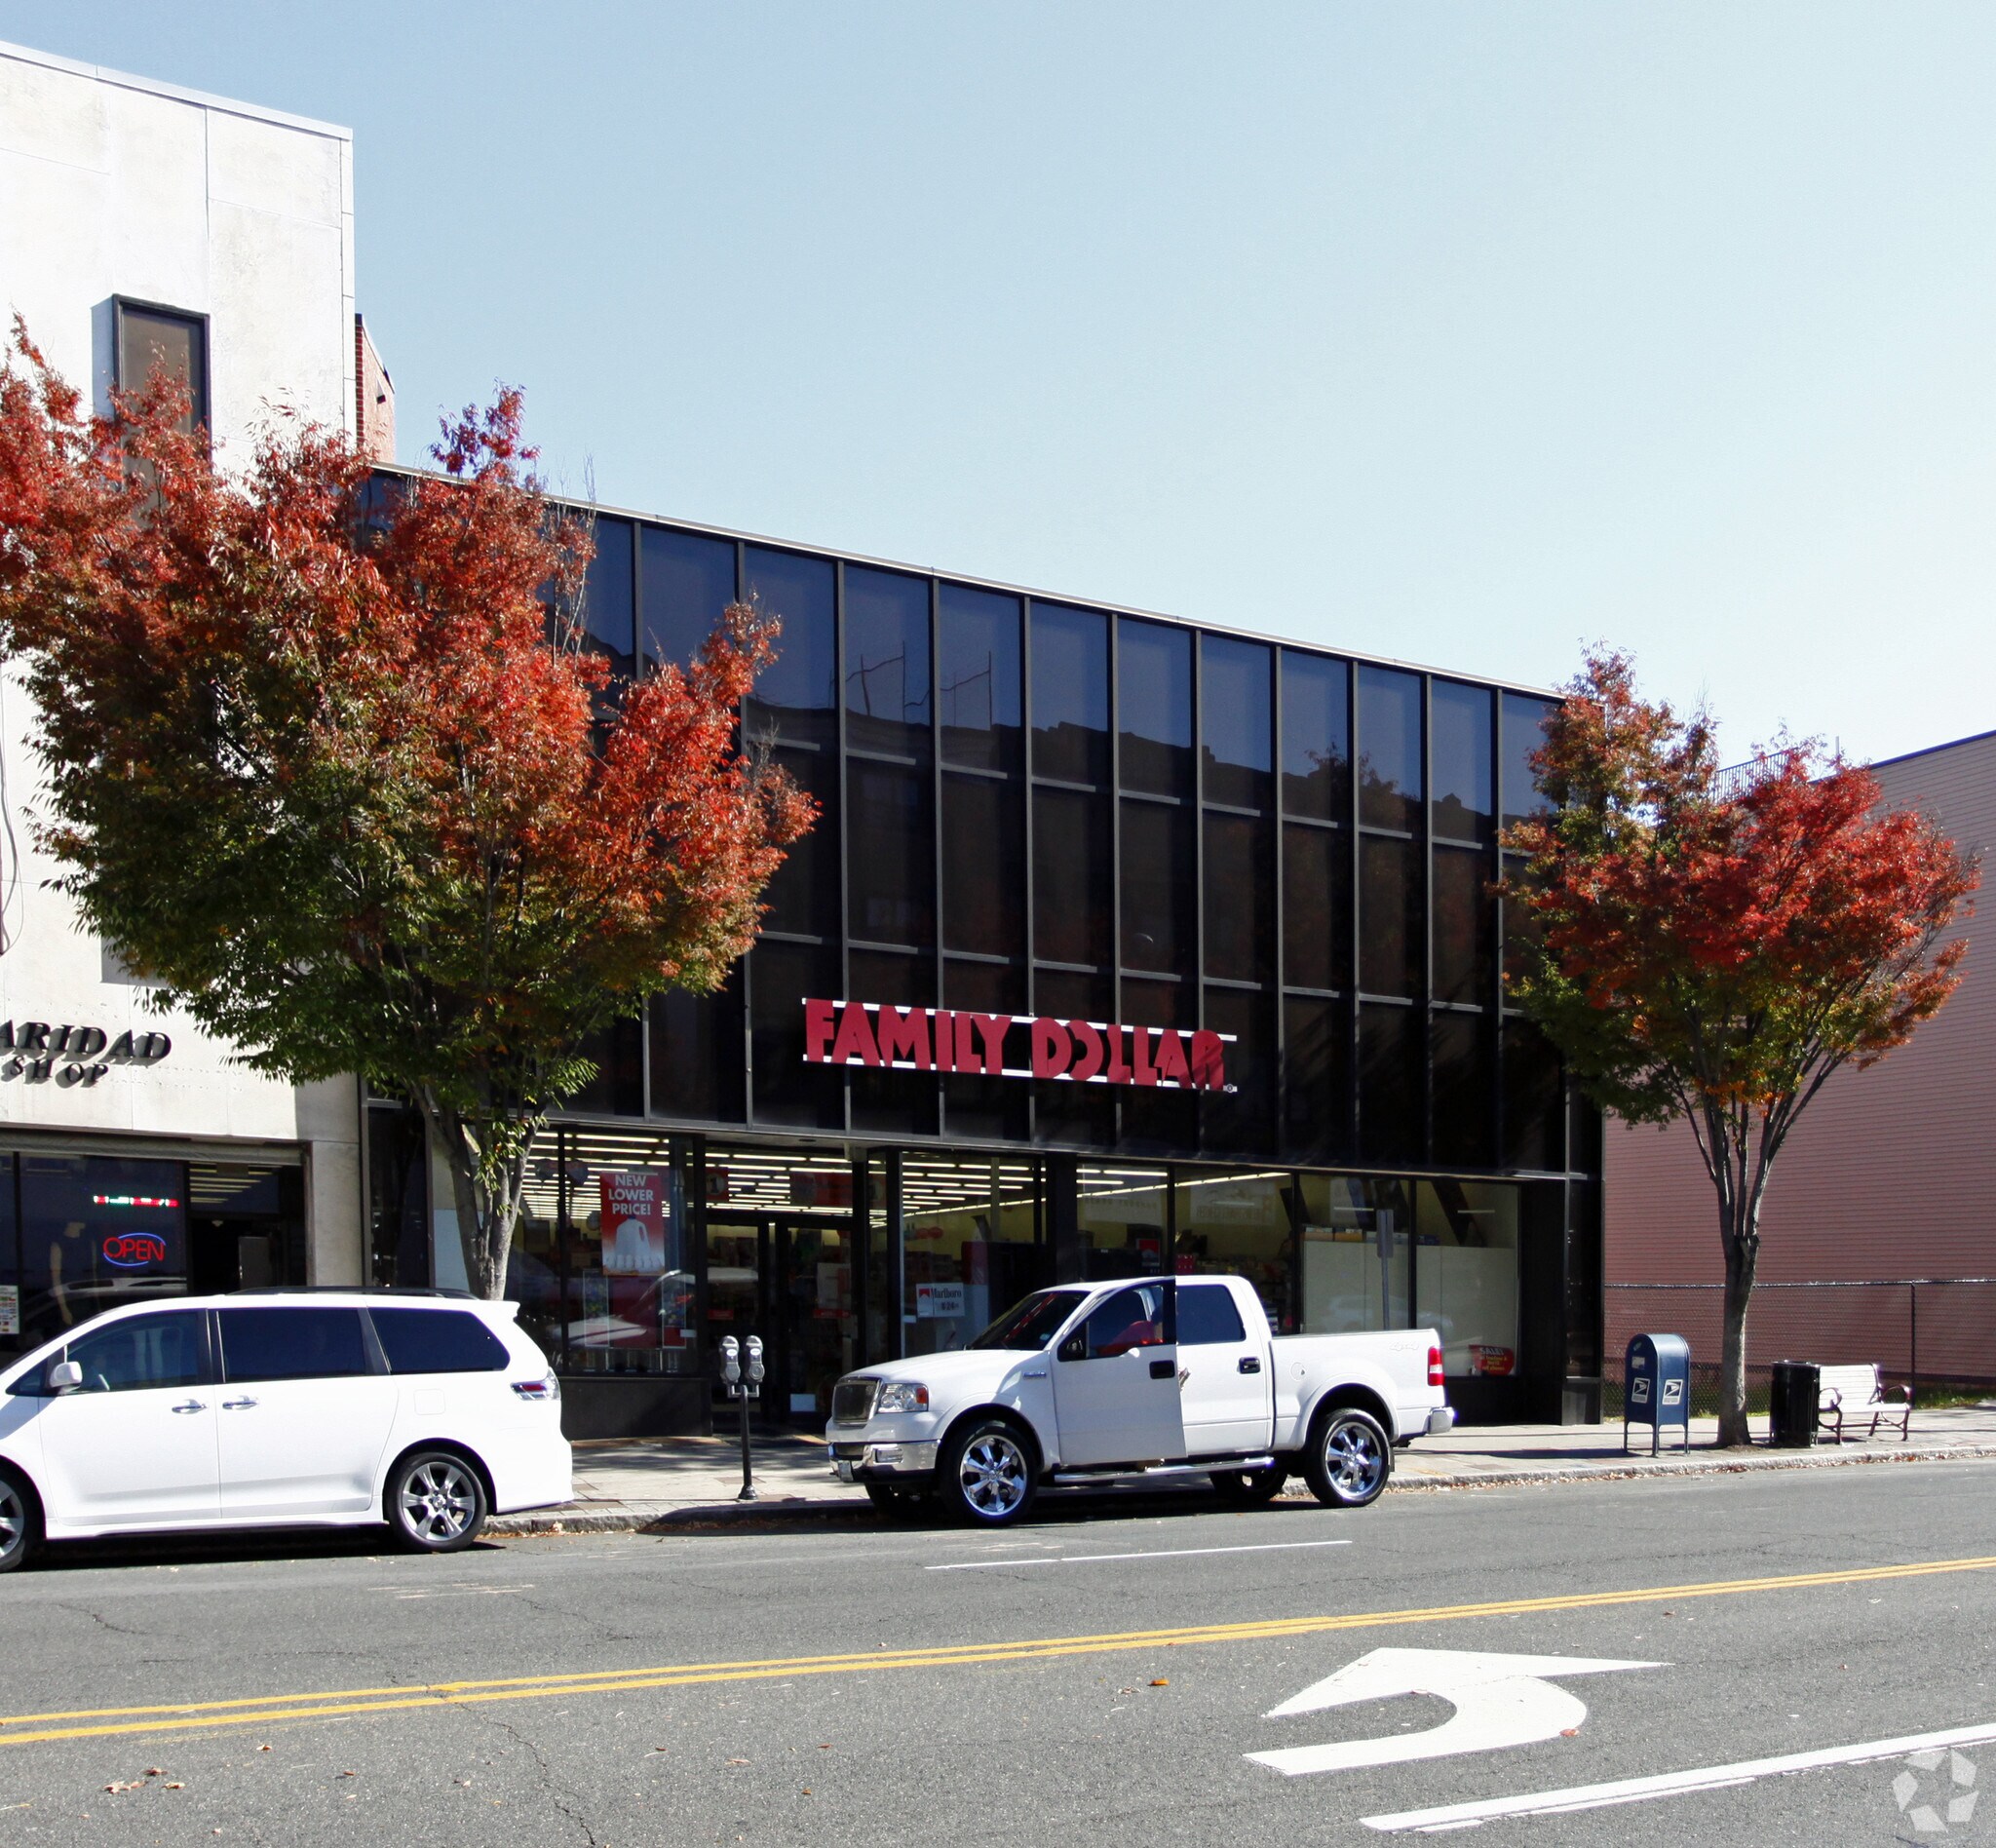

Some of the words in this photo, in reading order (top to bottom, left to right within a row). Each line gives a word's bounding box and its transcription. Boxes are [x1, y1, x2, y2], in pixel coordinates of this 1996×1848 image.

[806, 999, 1013, 1074] FAMILY
[1031, 1017, 1224, 1090] DOLLAR
[11, 1056, 108, 1082] SHOP
[616, 1174, 646, 1186] NEW
[608, 1188, 654, 1201] LOWER
[612, 1203, 651, 1215] PRICE!
[103, 1237, 164, 1261] OPEN
[931, 1287, 962, 1298] Marlboro
